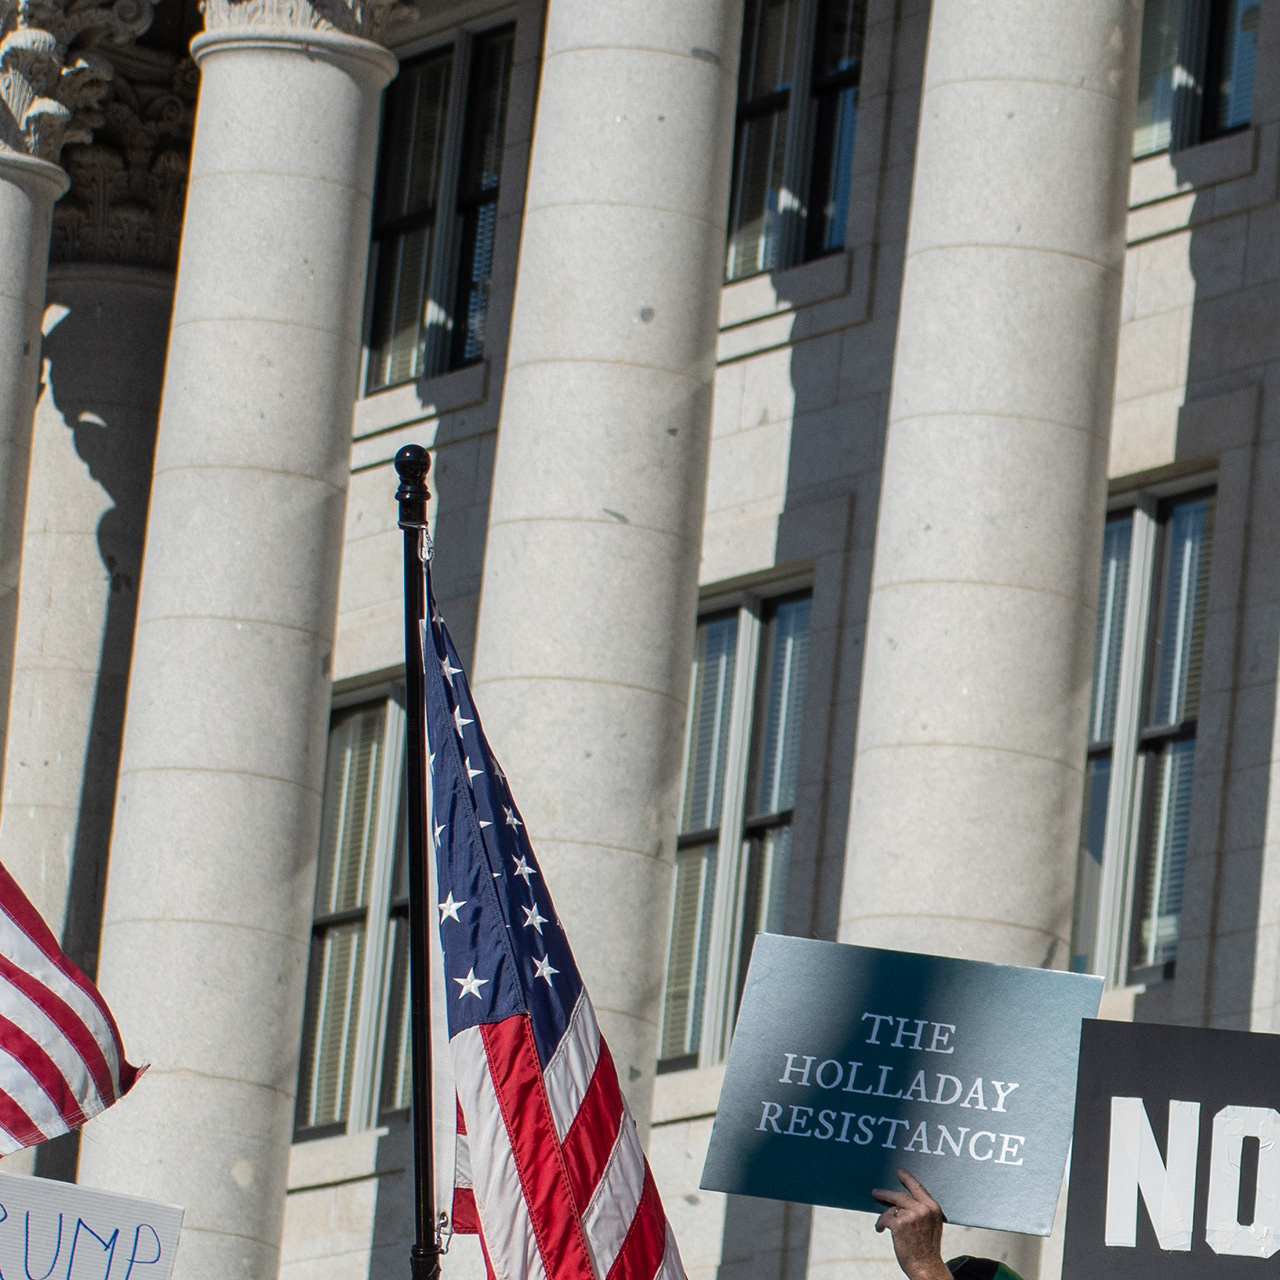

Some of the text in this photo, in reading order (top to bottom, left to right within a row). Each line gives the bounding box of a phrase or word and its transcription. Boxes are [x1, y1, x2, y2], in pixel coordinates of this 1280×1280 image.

[861, 1012, 956, 1054] THE
[779, 1054, 1019, 1112] HOLLADAY
[756, 1102, 1025, 1165] RESISTANCE
